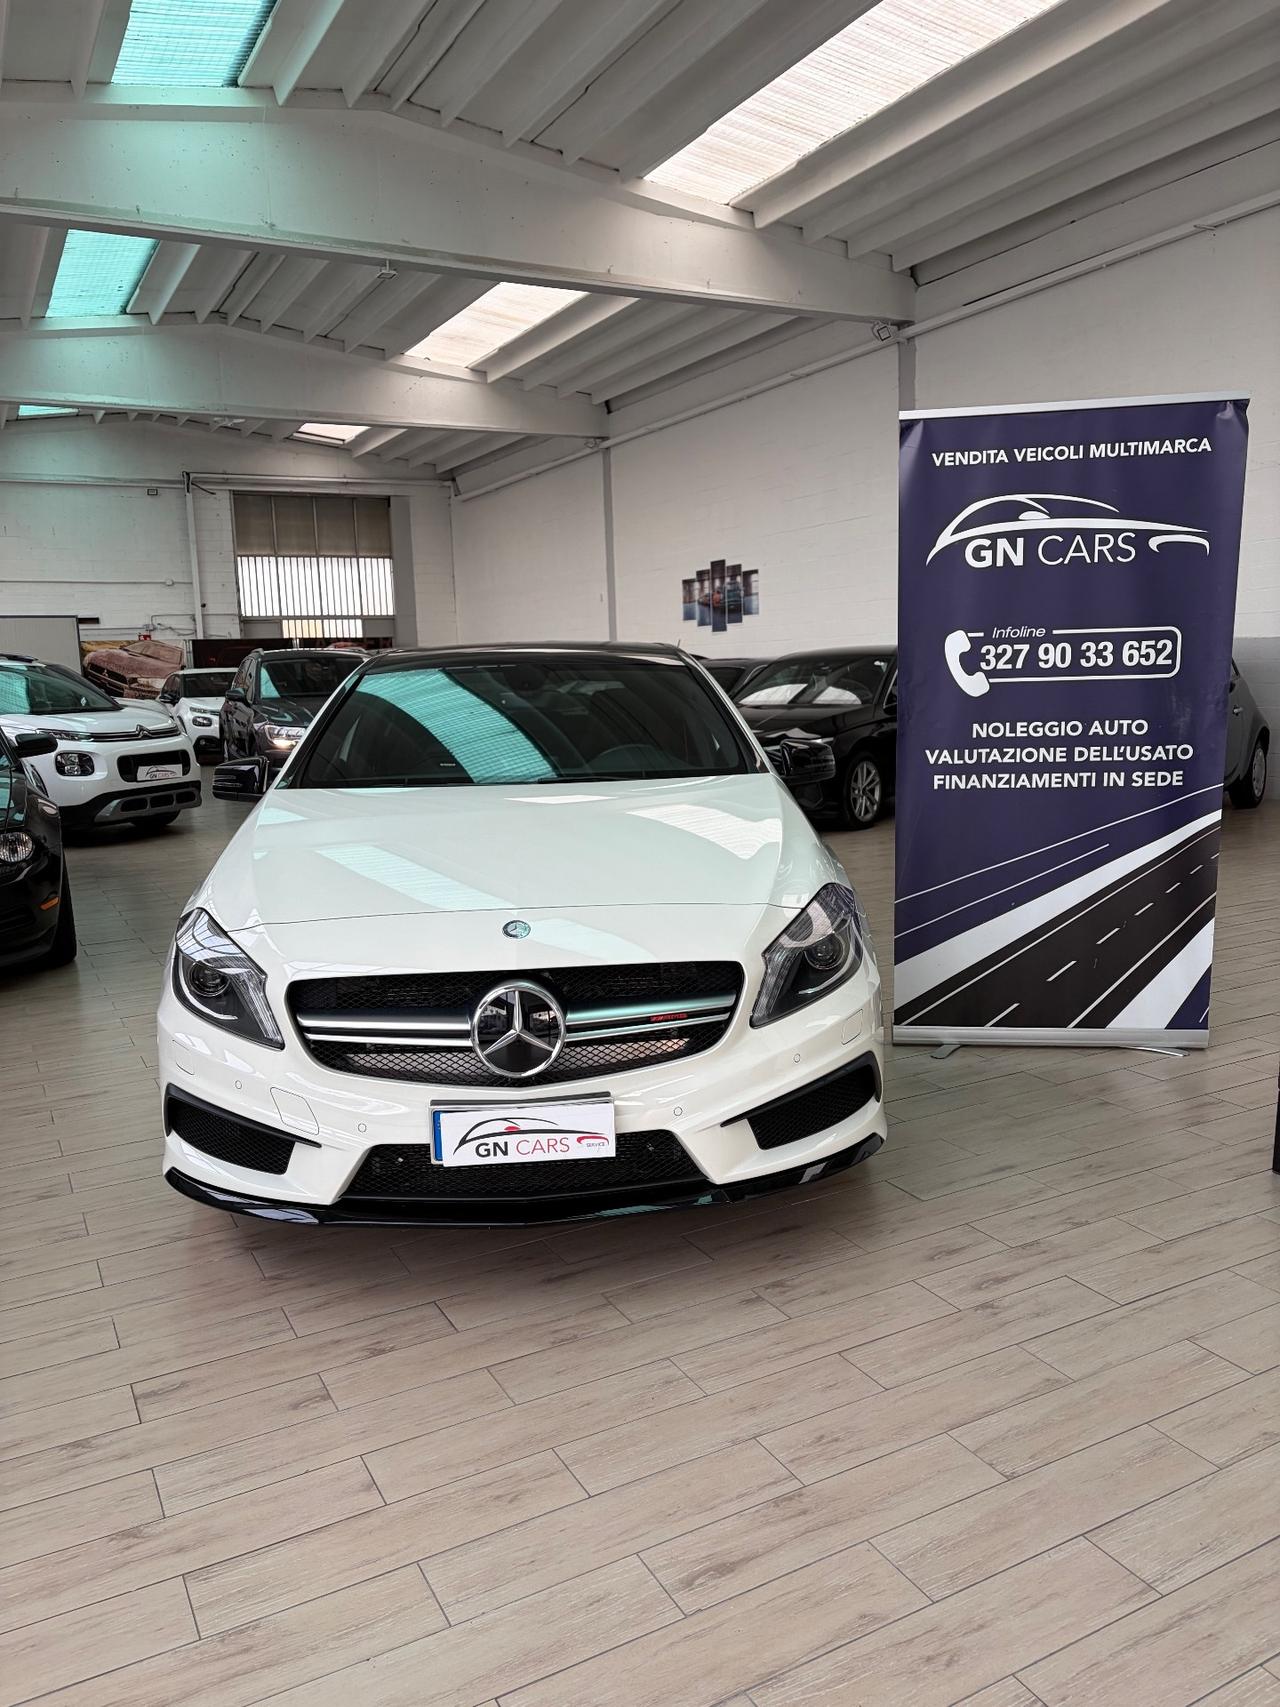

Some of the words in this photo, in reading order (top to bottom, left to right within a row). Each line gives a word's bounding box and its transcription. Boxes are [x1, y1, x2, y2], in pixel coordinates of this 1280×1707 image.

[932, 450, 1008, 466] VENDITA
[1014, 445, 1083, 462] VEICOLI
[1090, 438, 1211, 458] MULTIMARCA
[964, 538, 1024, 568] GN
[1038, 532, 1135, 565] CARS
[993, 626, 1045, 638] Infoline
[980, 644, 1029, 670] 327
[1038, 643, 1071, 668] 90
[1080, 642, 1113, 667] 33
[1123, 640, 1172, 666] 652
[973, 721, 1082, 738] NOLEGGIO
[1089, 720, 1148, 735] AUTO
[925, 748, 1066, 764] VALUTAZIONE
[1075, 744, 1193, 761] DELL'USATO
[934, 773, 1096, 789] FINANZIAMENTI
[1104, 772, 1124, 786] IN
[1132, 771, 1183, 786] SEDE
[475, 1142, 508, 1157] GN
[516, 1137, 569, 1155] CARS
